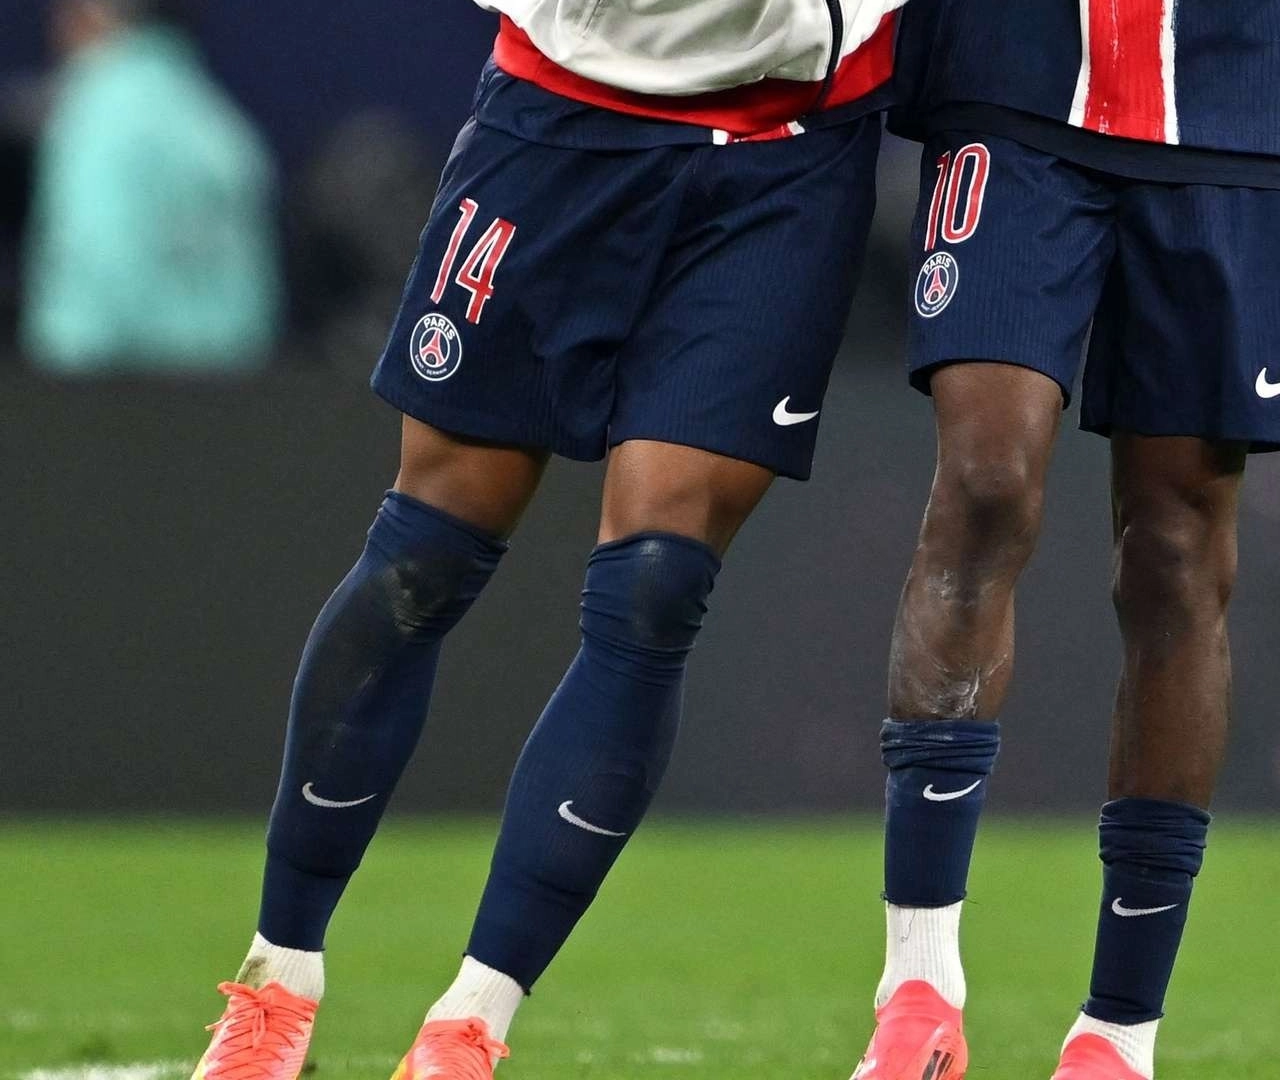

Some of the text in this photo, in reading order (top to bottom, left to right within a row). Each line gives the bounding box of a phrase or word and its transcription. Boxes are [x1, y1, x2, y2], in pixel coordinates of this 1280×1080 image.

[924, 142, 991, 252] 10
[430, 197, 517, 325] 14
[923, 255, 952, 275] PARIS
[423, 316, 456, 341] PARIS
